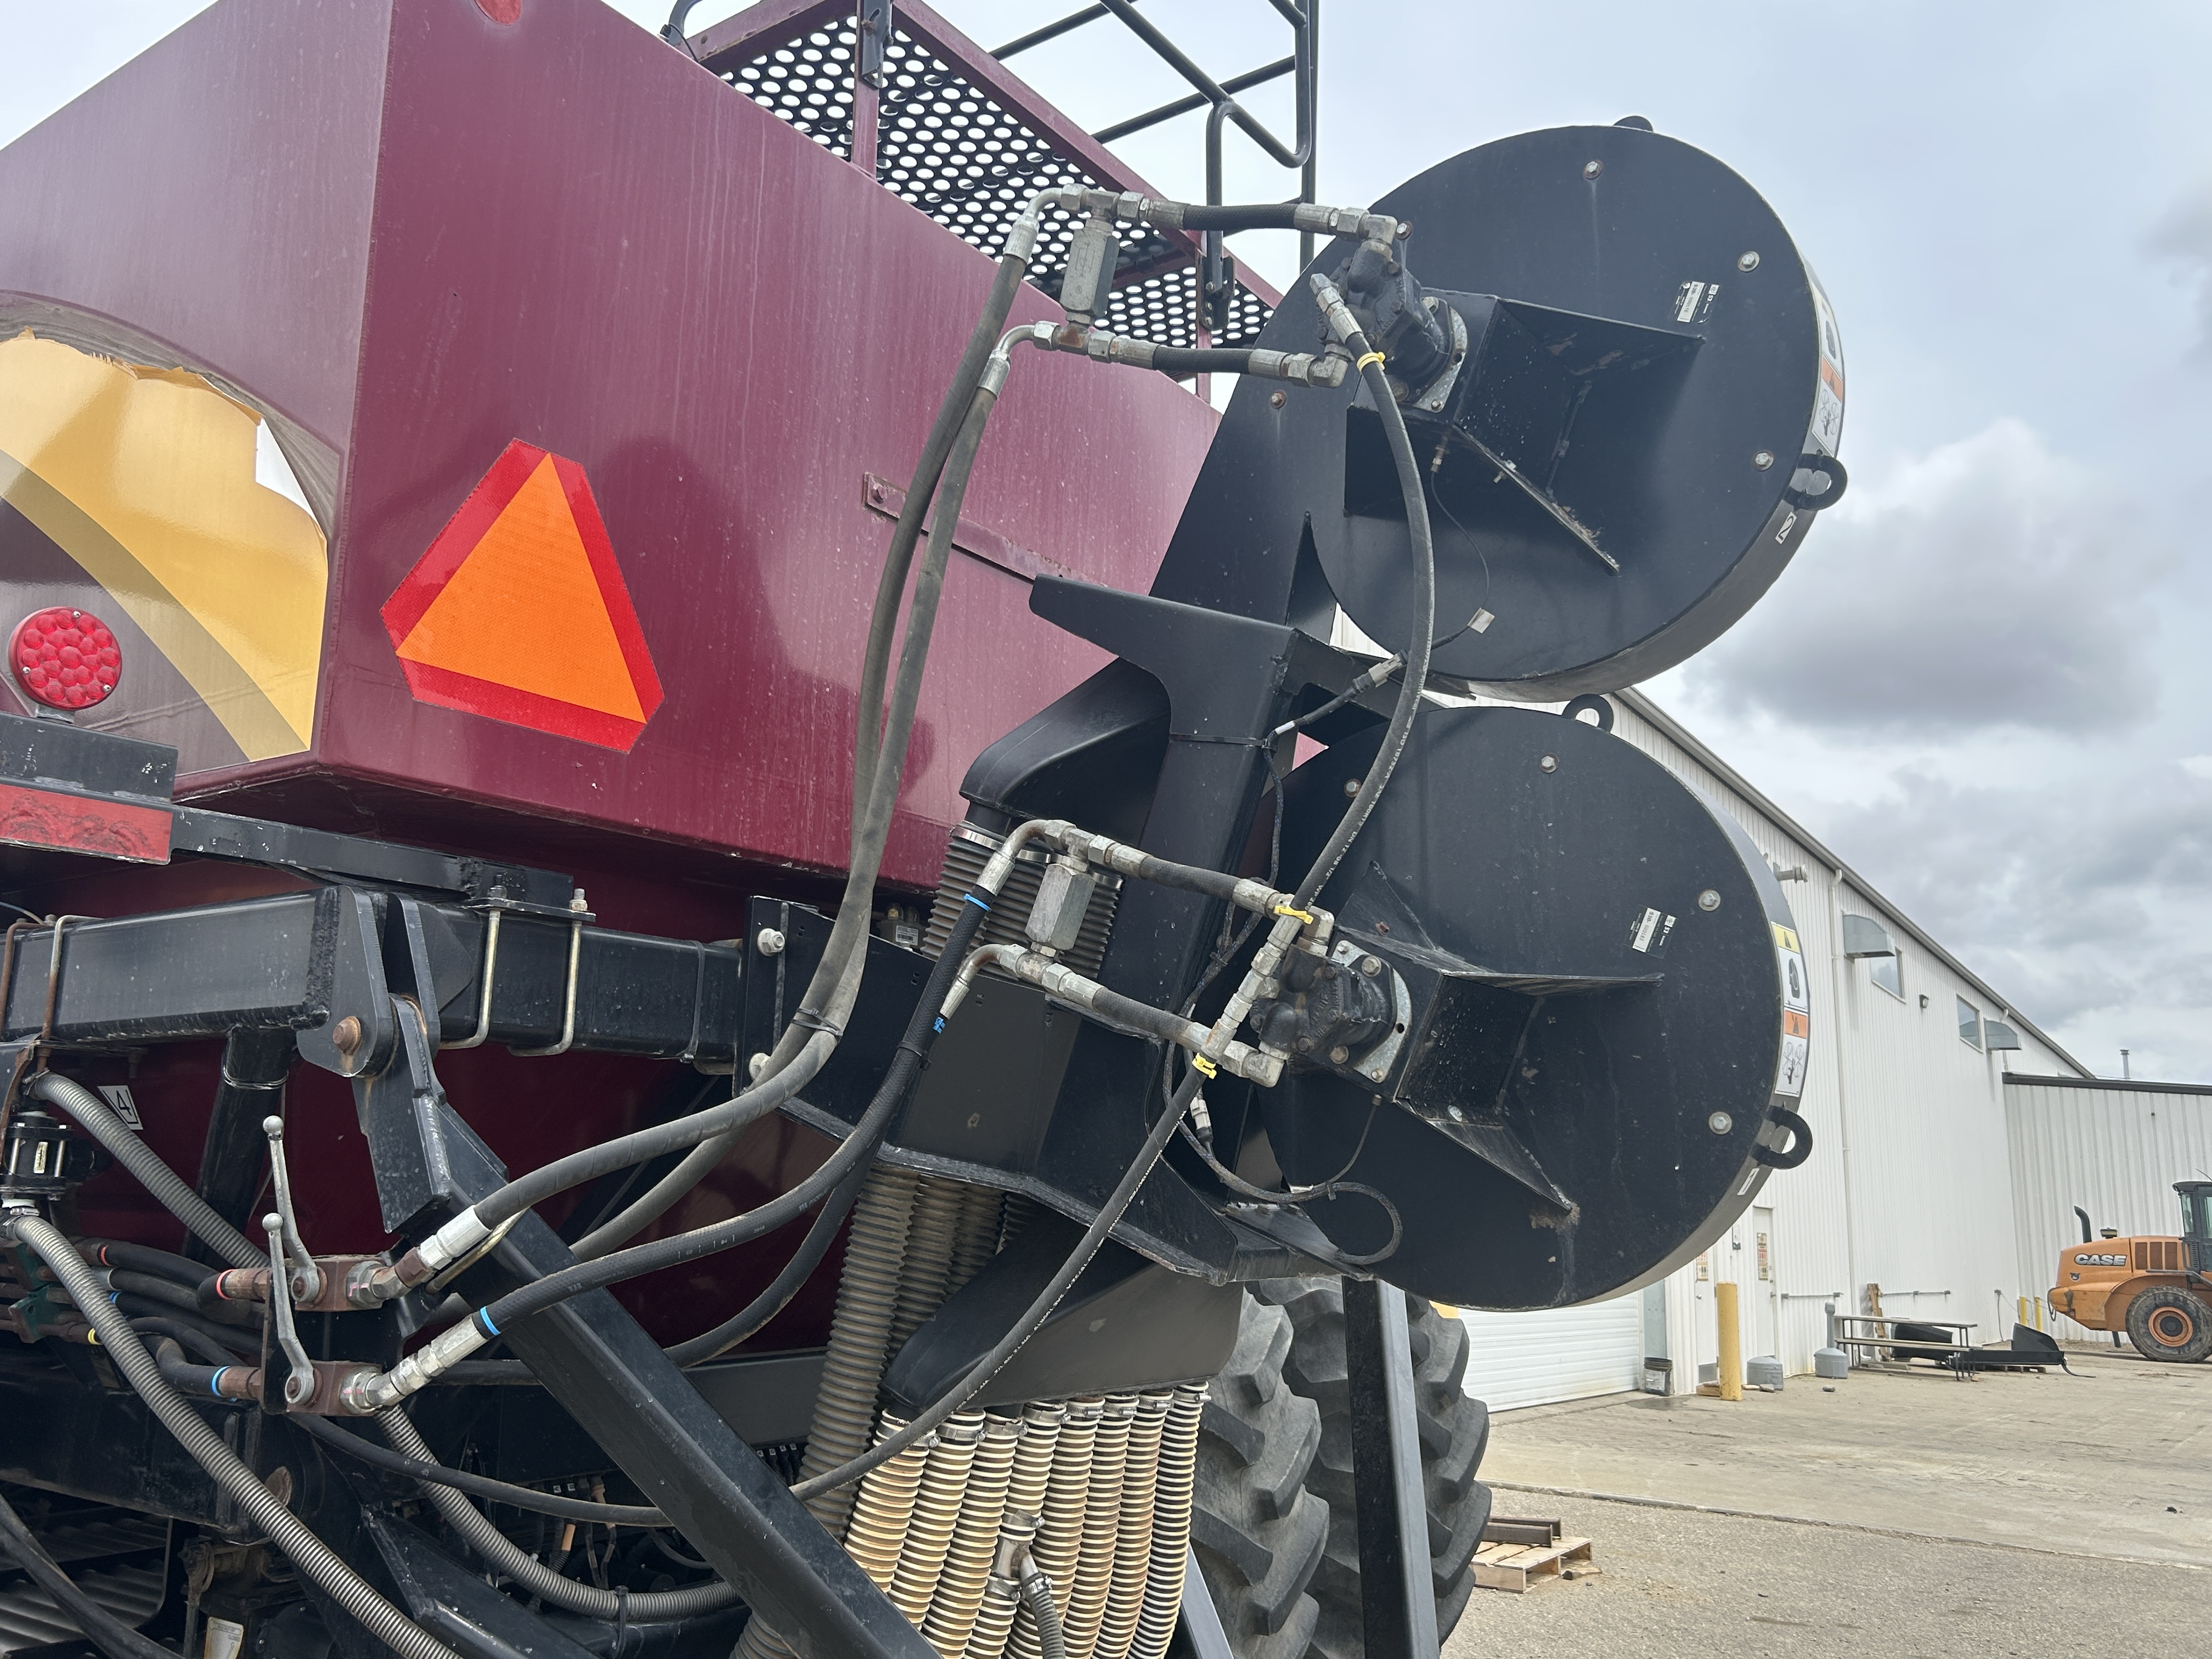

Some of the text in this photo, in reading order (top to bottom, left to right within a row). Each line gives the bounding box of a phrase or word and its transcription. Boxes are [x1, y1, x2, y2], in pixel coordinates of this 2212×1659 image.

[1778, 515, 1794, 540] 2
[1347, 830, 1357, 843] DN
[1312, 883, 1323, 897] WP
[116, 1090, 132, 1116] 4
[2075, 1254, 2126, 1266] CASE
